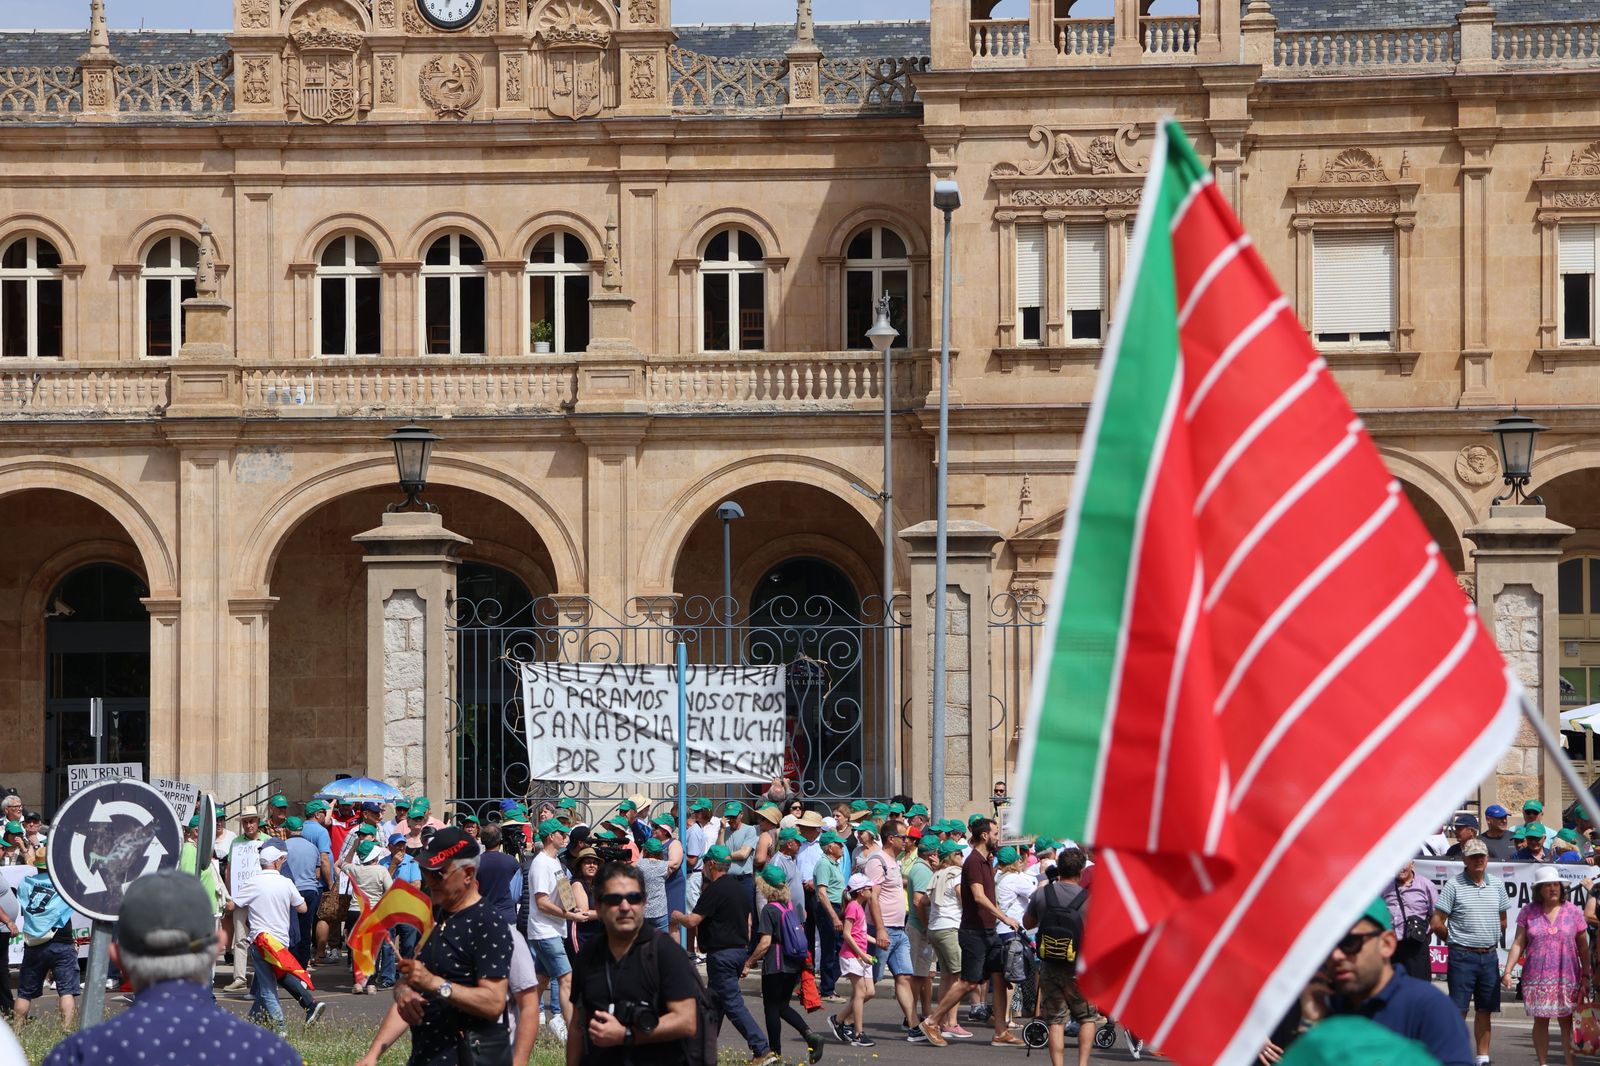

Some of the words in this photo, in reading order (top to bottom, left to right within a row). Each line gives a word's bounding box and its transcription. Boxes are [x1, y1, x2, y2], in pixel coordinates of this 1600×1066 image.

[595, 664, 655, 686] AVE
[705, 665, 778, 687] PARA
[530, 686, 555, 709] LO
[566, 685, 669, 711] PARAMOS
[532, 710, 674, 744] SANABRIA
[686, 714, 714, 743] EN
[720, 716, 785, 743] LUCHA
[557, 746, 600, 773] POR
[614, 747, 656, 774] SUS
[70, 767, 88, 780] SIN
[123, 766, 135, 778] AL
[160, 779, 173, 789] SIN
[175, 782, 190, 792] AVE
[429, 840, 469, 865] HONDA
